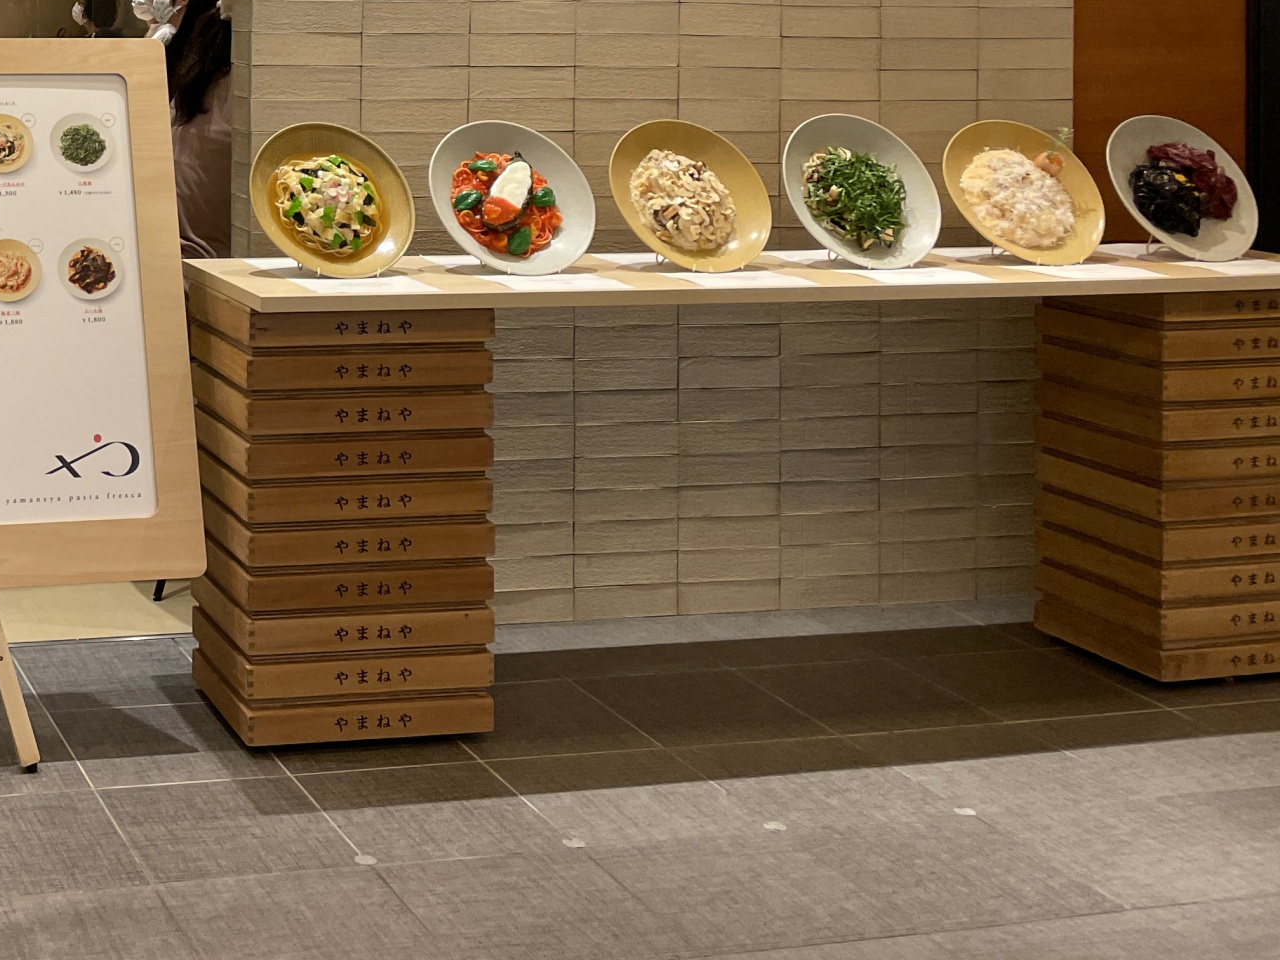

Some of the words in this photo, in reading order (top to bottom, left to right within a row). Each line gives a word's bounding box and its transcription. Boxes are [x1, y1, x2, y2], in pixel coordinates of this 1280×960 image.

[336, 321, 412, 335] やまねや
[335, 364, 412, 378] やまねや
[336, 408, 411, 423] やまねや
[336, 451, 411, 466] やまねや
[6, 497, 61, 505] yamaneya
[69, 494, 99, 502] pasta
[337, 494, 411, 510] やまねや
[335, 538, 412, 554] やまねや
[336, 581, 411, 597] やまねや
[335, 625, 412, 642] やまねや
[336, 668, 412, 685] やまねや
[335, 714, 412, 731] やまねや
